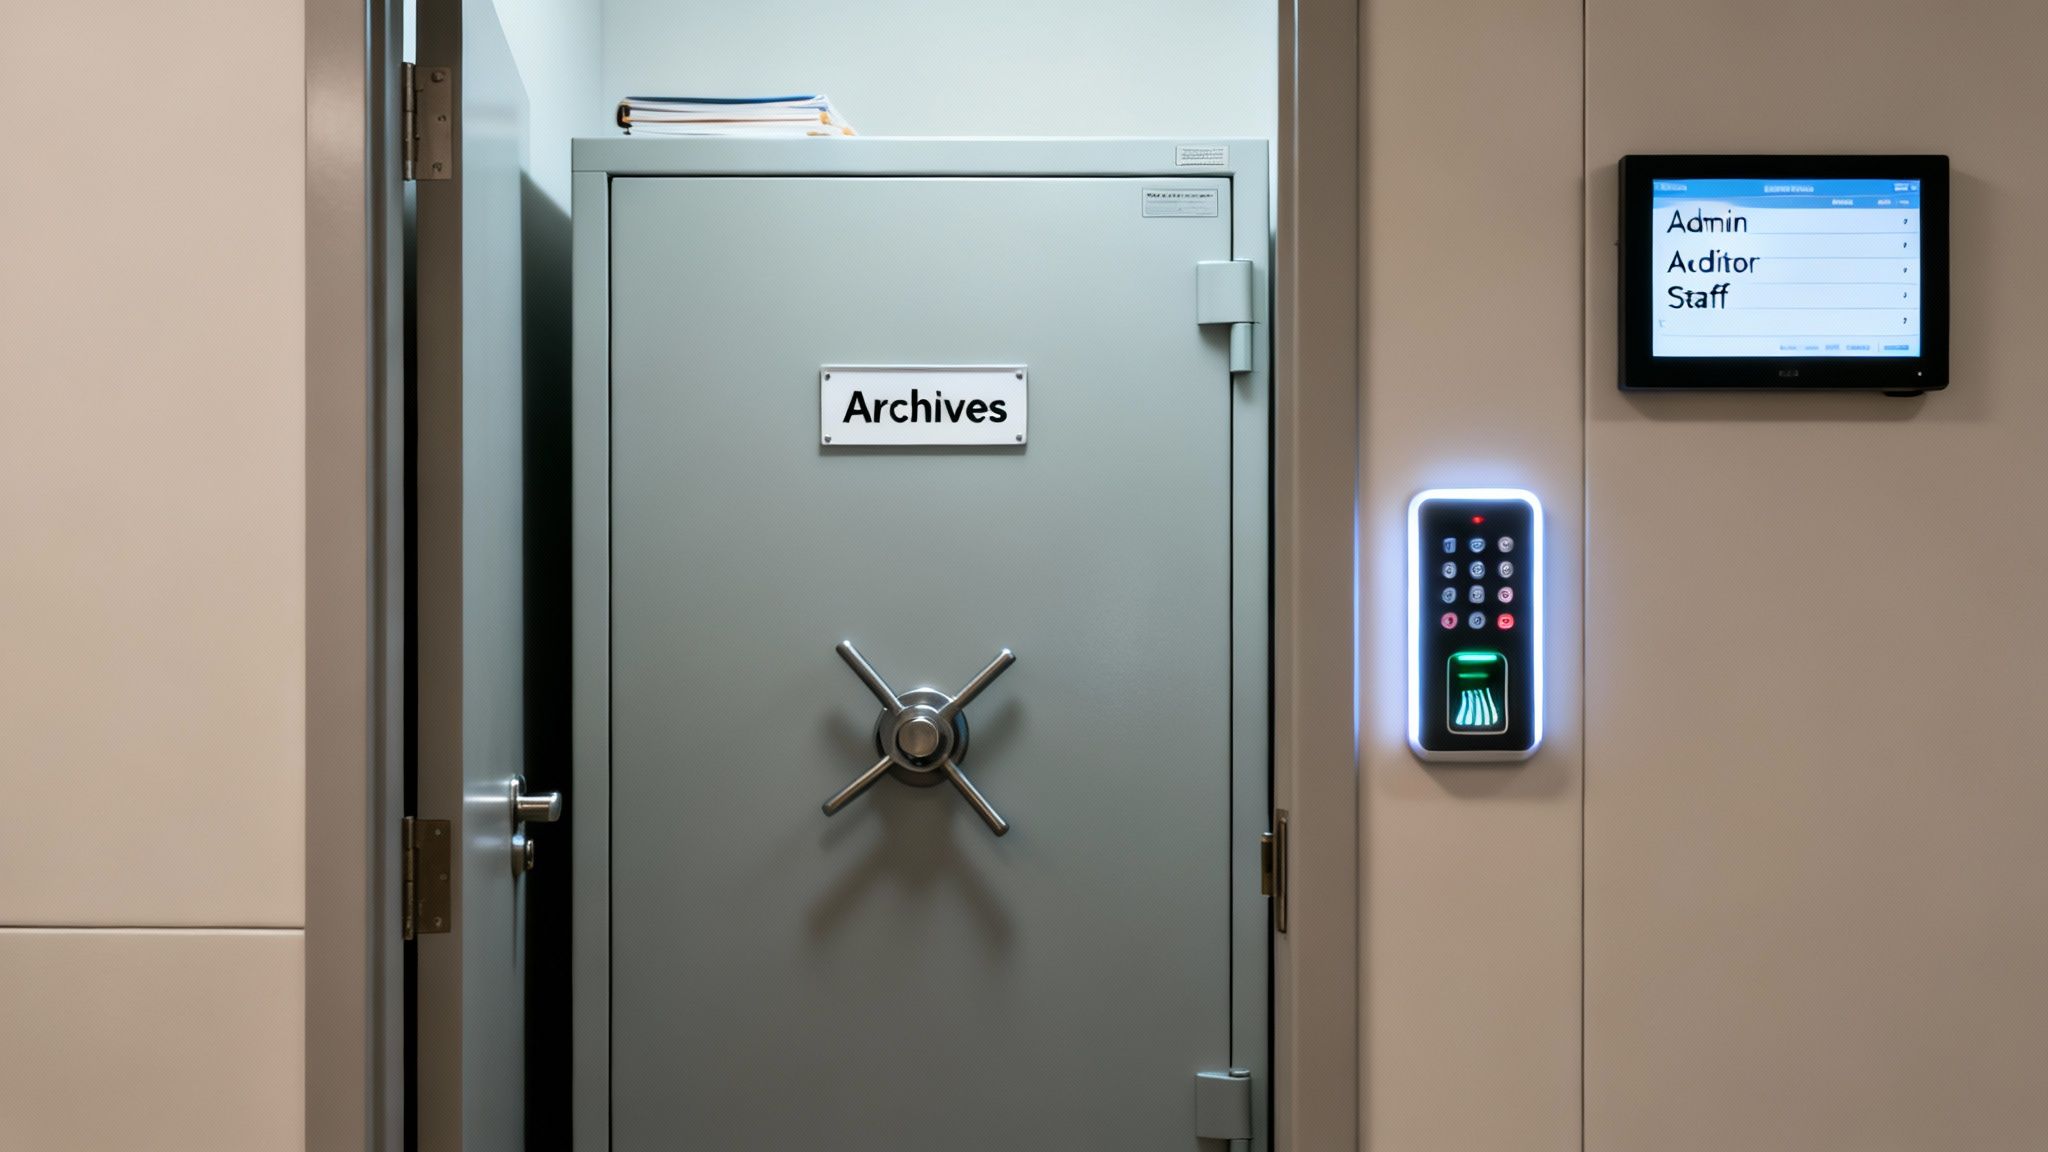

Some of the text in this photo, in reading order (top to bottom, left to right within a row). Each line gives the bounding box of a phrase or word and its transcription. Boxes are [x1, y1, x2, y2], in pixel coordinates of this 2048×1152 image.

[1667, 208, 1747, 233] Admin
[1668, 283, 1730, 309] Staff
[842, 388, 1008, 423] Archives
